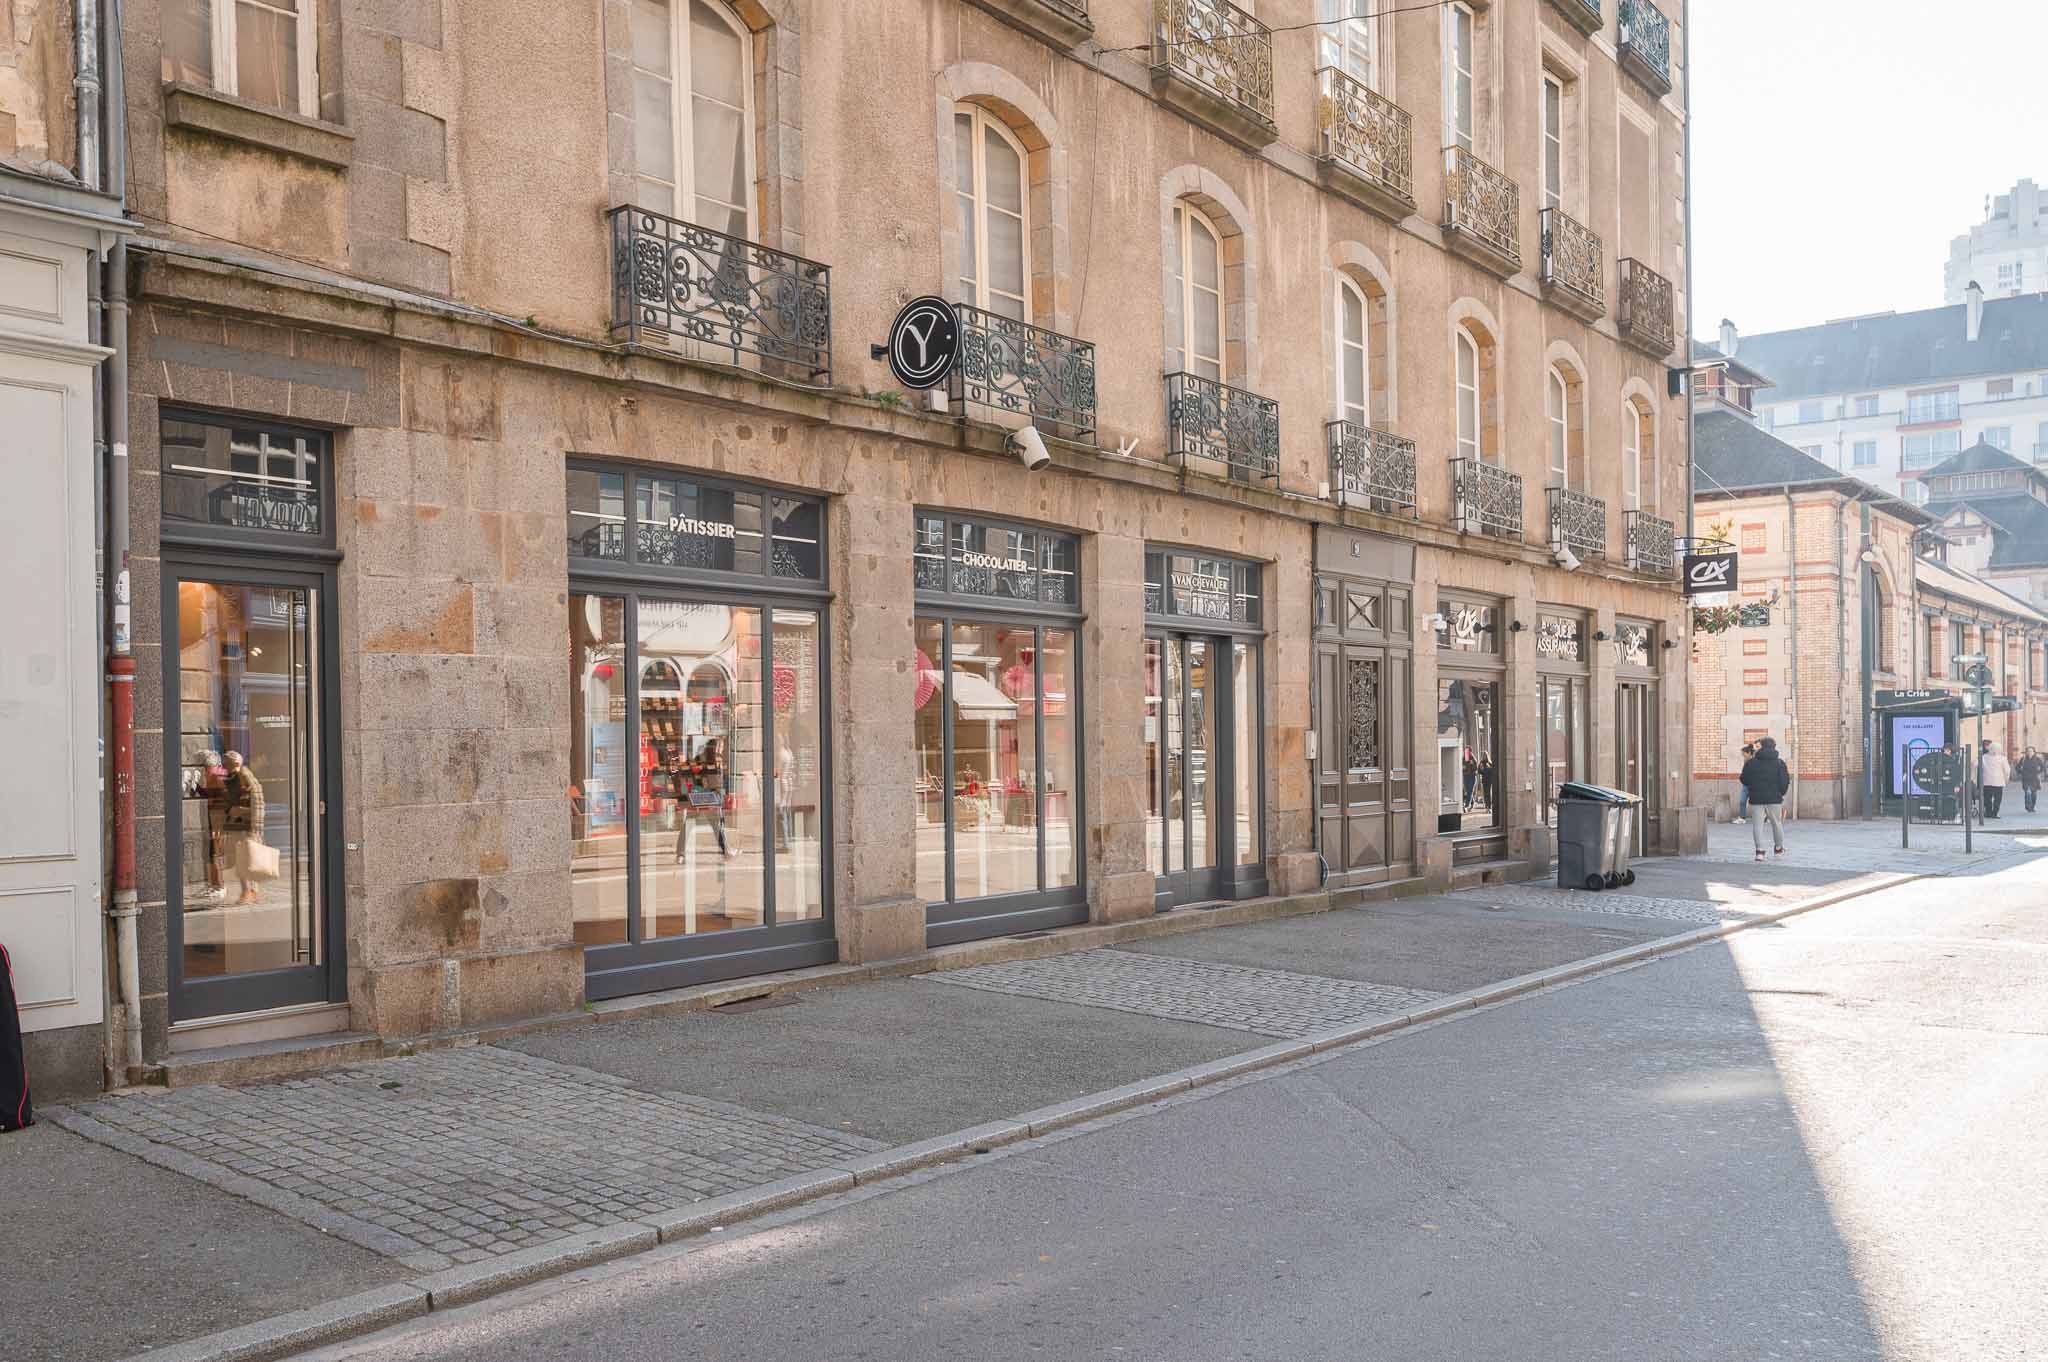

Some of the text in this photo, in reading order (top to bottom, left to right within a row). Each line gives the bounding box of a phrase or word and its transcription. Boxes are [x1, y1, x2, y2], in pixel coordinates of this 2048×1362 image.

[669, 513, 735, 539] PÂTISSIER
[962, 553, 1028, 573] CHOCOLATIER
[1537, 638, 1578, 656] ASSURANCES
